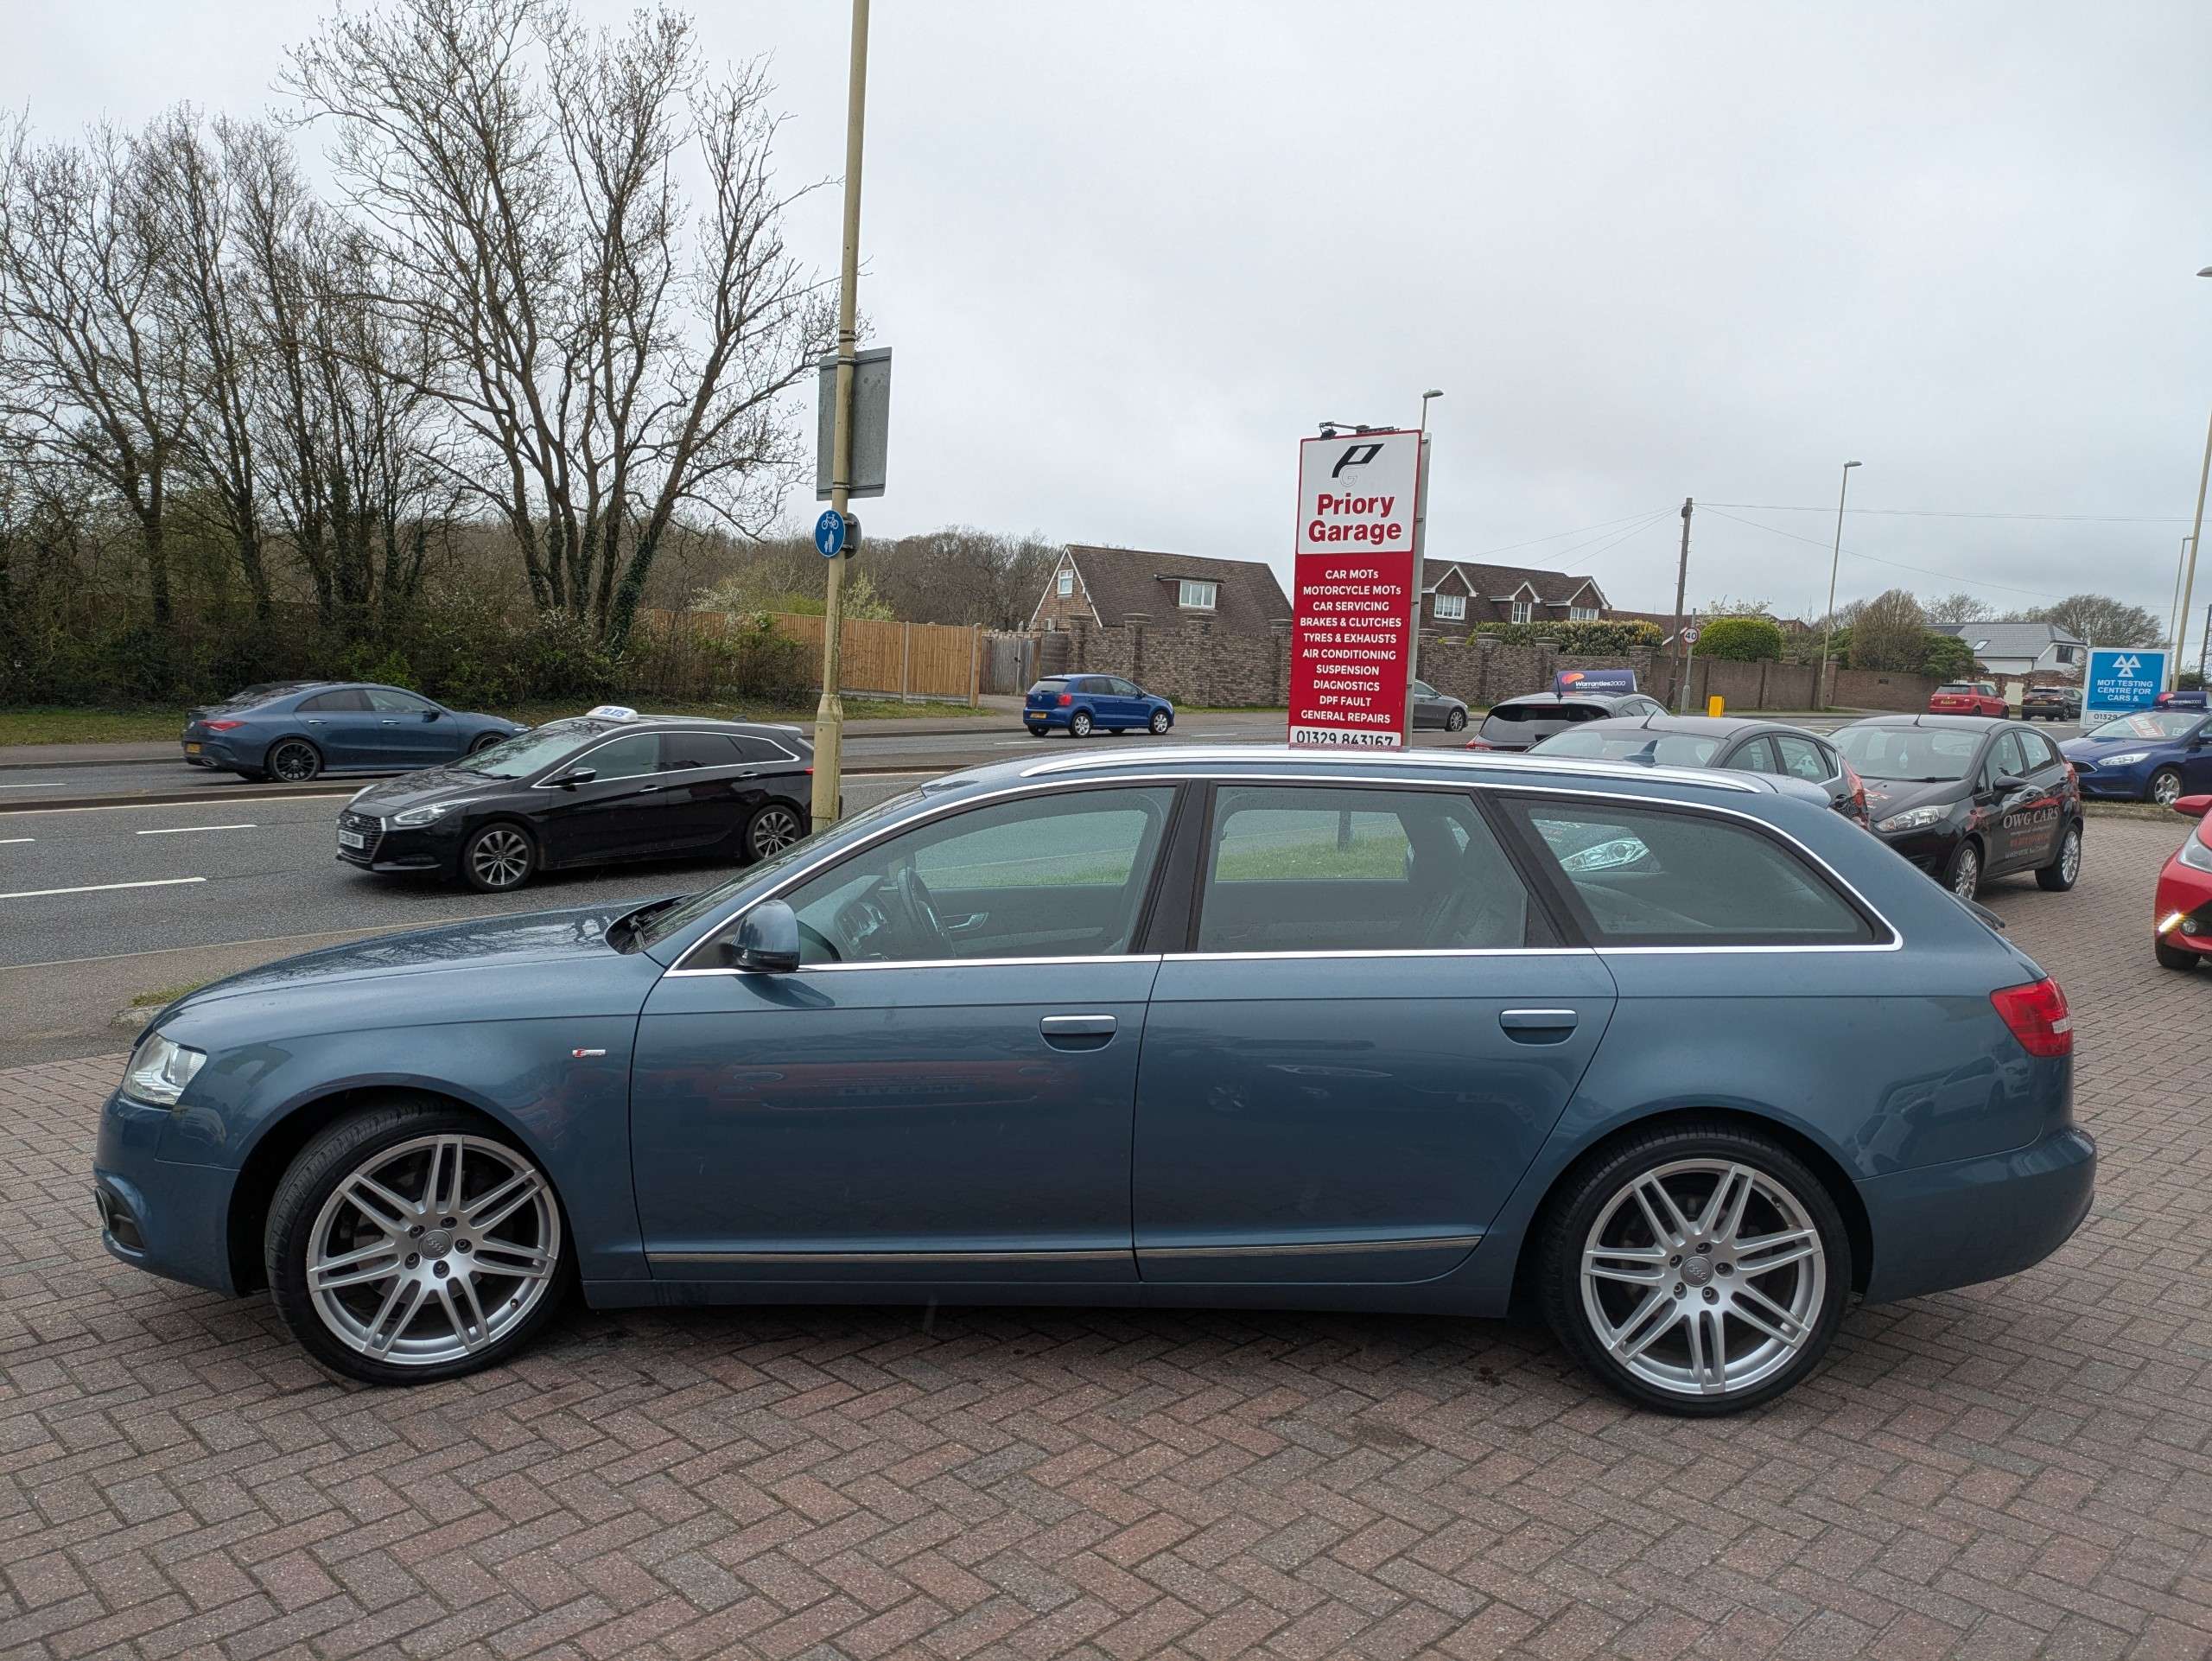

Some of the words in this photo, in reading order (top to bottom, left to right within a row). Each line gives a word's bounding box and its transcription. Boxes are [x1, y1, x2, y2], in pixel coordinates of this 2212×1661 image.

[1317, 493, 1395, 518] Priory
[1308, 520, 1402, 545] Garage
[1325, 570, 1346, 579] CAR
[1350, 570, 1379, 579] MOTs
[1303, 586, 1370, 595] MOTORCYCLE
[1373, 586, 1402, 595] MOTs
[1313, 602, 1333, 611] CAR
[1335, 601, 1389, 611] SERVICING
[1300, 618, 1338, 627] BRAKES
[1340, 618, 1347, 627] &
[1349, 618, 1402, 627] CLUTCHES
[1303, 633, 1332, 643] TYRES
[1335, 633, 1341, 643] &
[1344, 633, 1396, 644] EXHAUSTS
[1302, 649, 1319, 658] AIR
[1321, 649, 1396, 660] CONDITIONING
[1316, 665, 1380, 676] SUSPENSION
[1313, 680, 1380, 691] DIAGNOSTICS
[2117, 679, 2153, 688] TESTING
[1319, 696, 1338, 705] DPF
[1340, 697, 1371, 707] FAULT
[1301, 710, 1345, 722] GENERAL
[1348, 713, 1390, 723] REPAIRS
[1297, 730, 1337, 743] 01329
[1342, 733, 1394, 747] 843167
[2003, 812, 2031, 829] OWG
[2033, 806, 2060, 823] CARS
